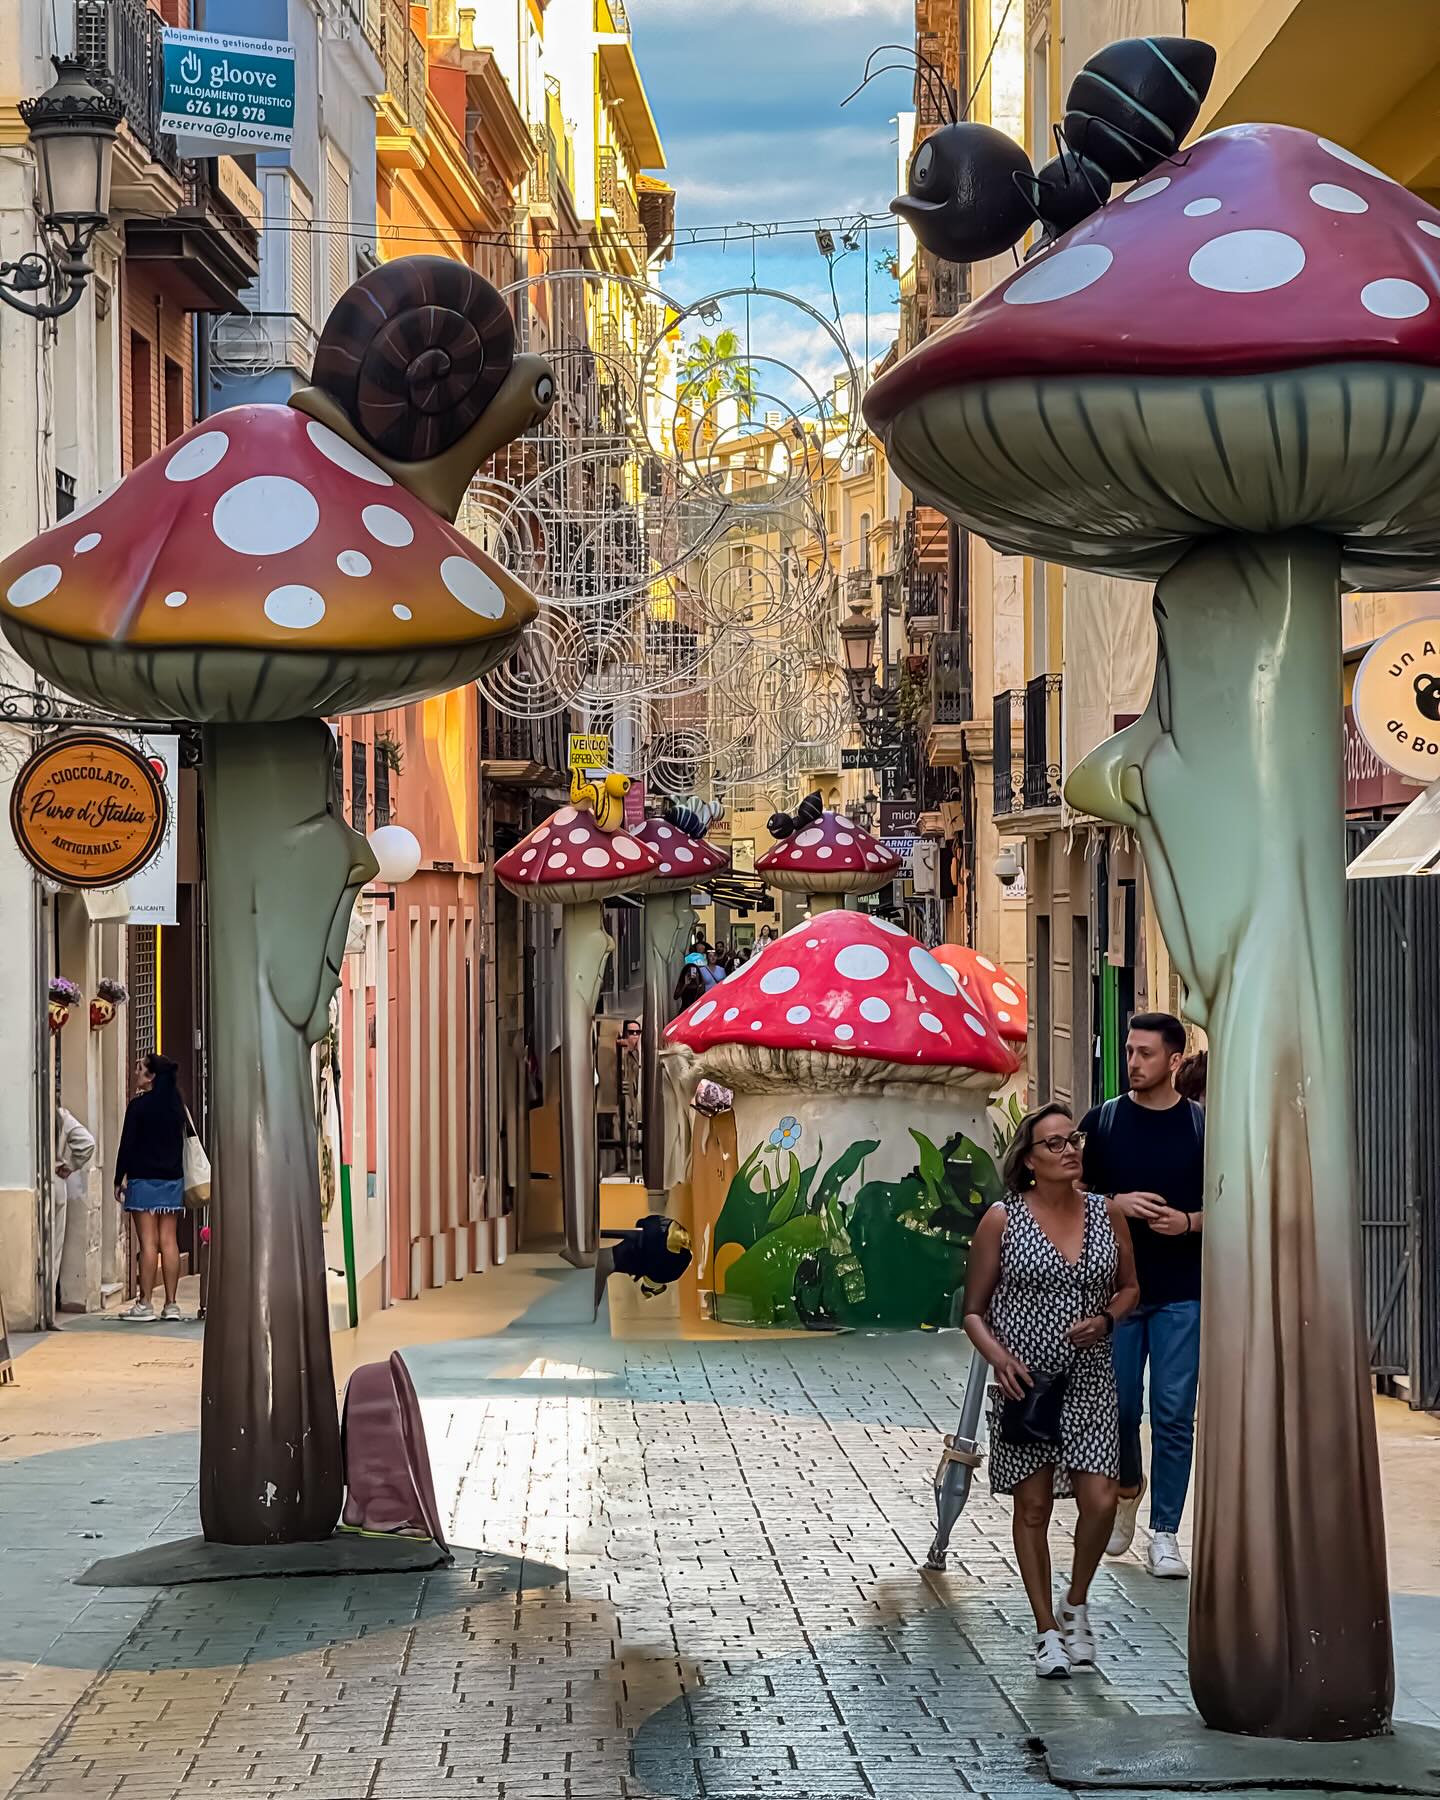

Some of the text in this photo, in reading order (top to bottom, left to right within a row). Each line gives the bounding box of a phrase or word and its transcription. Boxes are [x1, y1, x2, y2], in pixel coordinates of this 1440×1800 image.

[164, 29, 219, 44] Alojamiento
[222, 39, 273, 52] gestionado
[210, 59, 277, 88] gloove
[170, 84, 292, 108] TU ALOJAMIENTO TURISTICO
[186, 100, 266, 121] 676 149 978
[161, 118, 292, 143] reserva@gloove.me
[1388, 641, 1440, 677] un A
[1386, 720, 1409, 743] de
[572, 738, 606, 750] VENDO
[51, 767, 130, 790] CIOCCOLATO
[30, 789, 146, 828] Puro d'Italia
[51, 835, 122, 855] ARTIGIANALE
